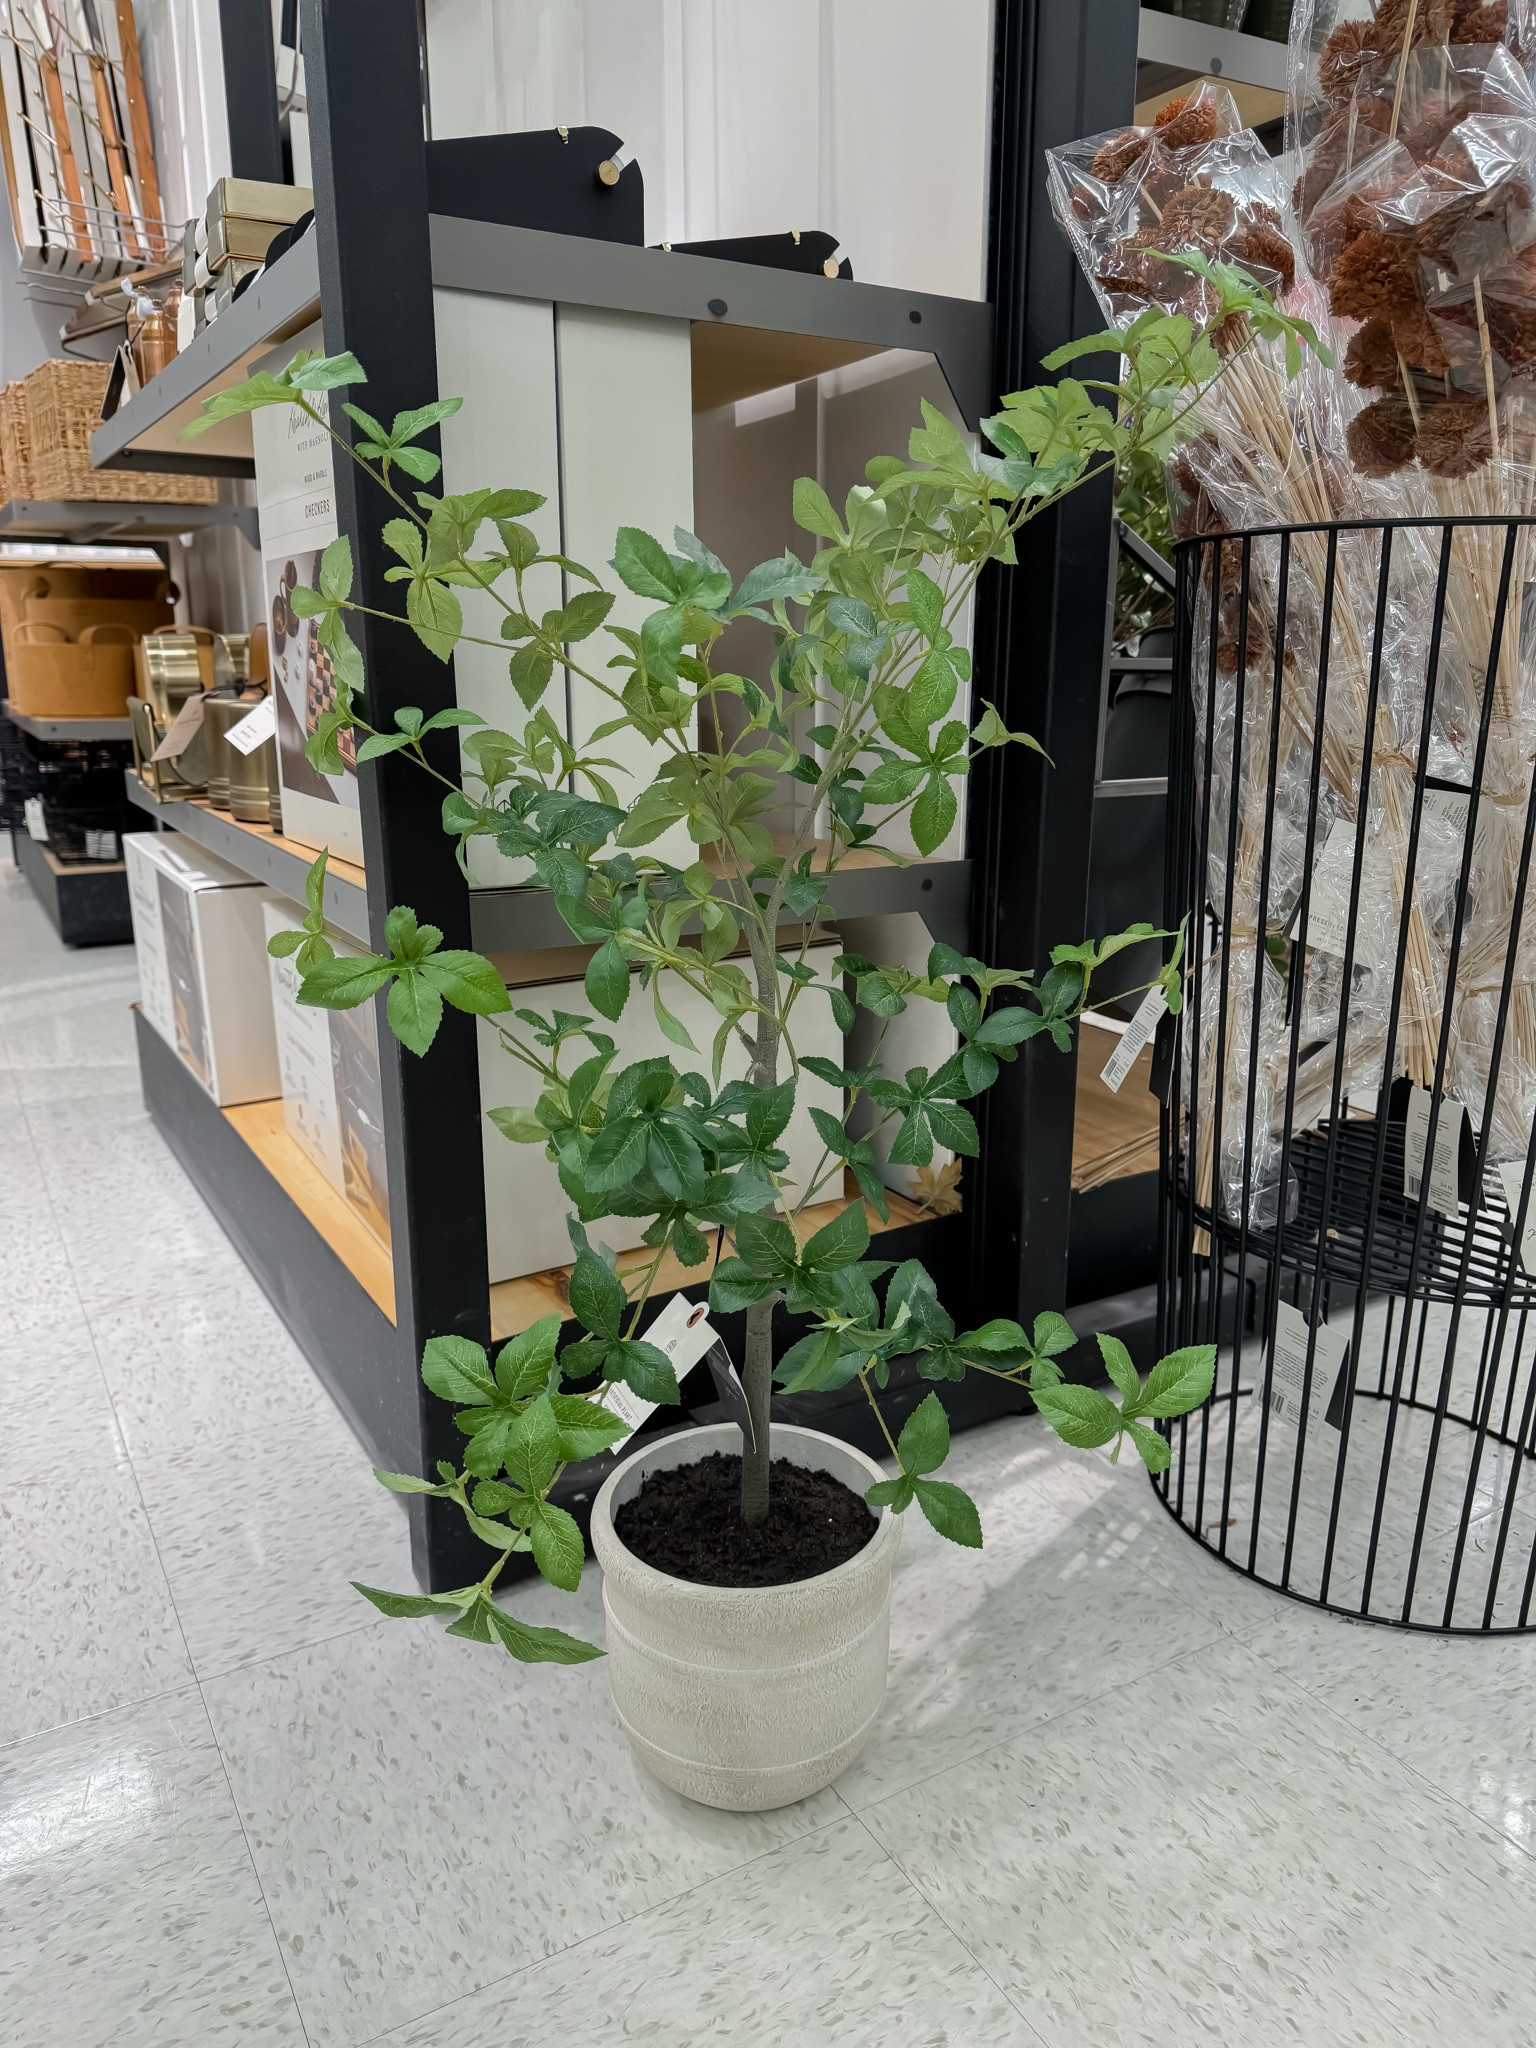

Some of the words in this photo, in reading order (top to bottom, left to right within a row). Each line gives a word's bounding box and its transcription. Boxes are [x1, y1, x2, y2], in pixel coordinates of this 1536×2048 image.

[309, 431, 330, 448] MAGNOLI
[305, 499, 330, 518] CHECKERS
[621, 1406, 632, 1421] PLANT
